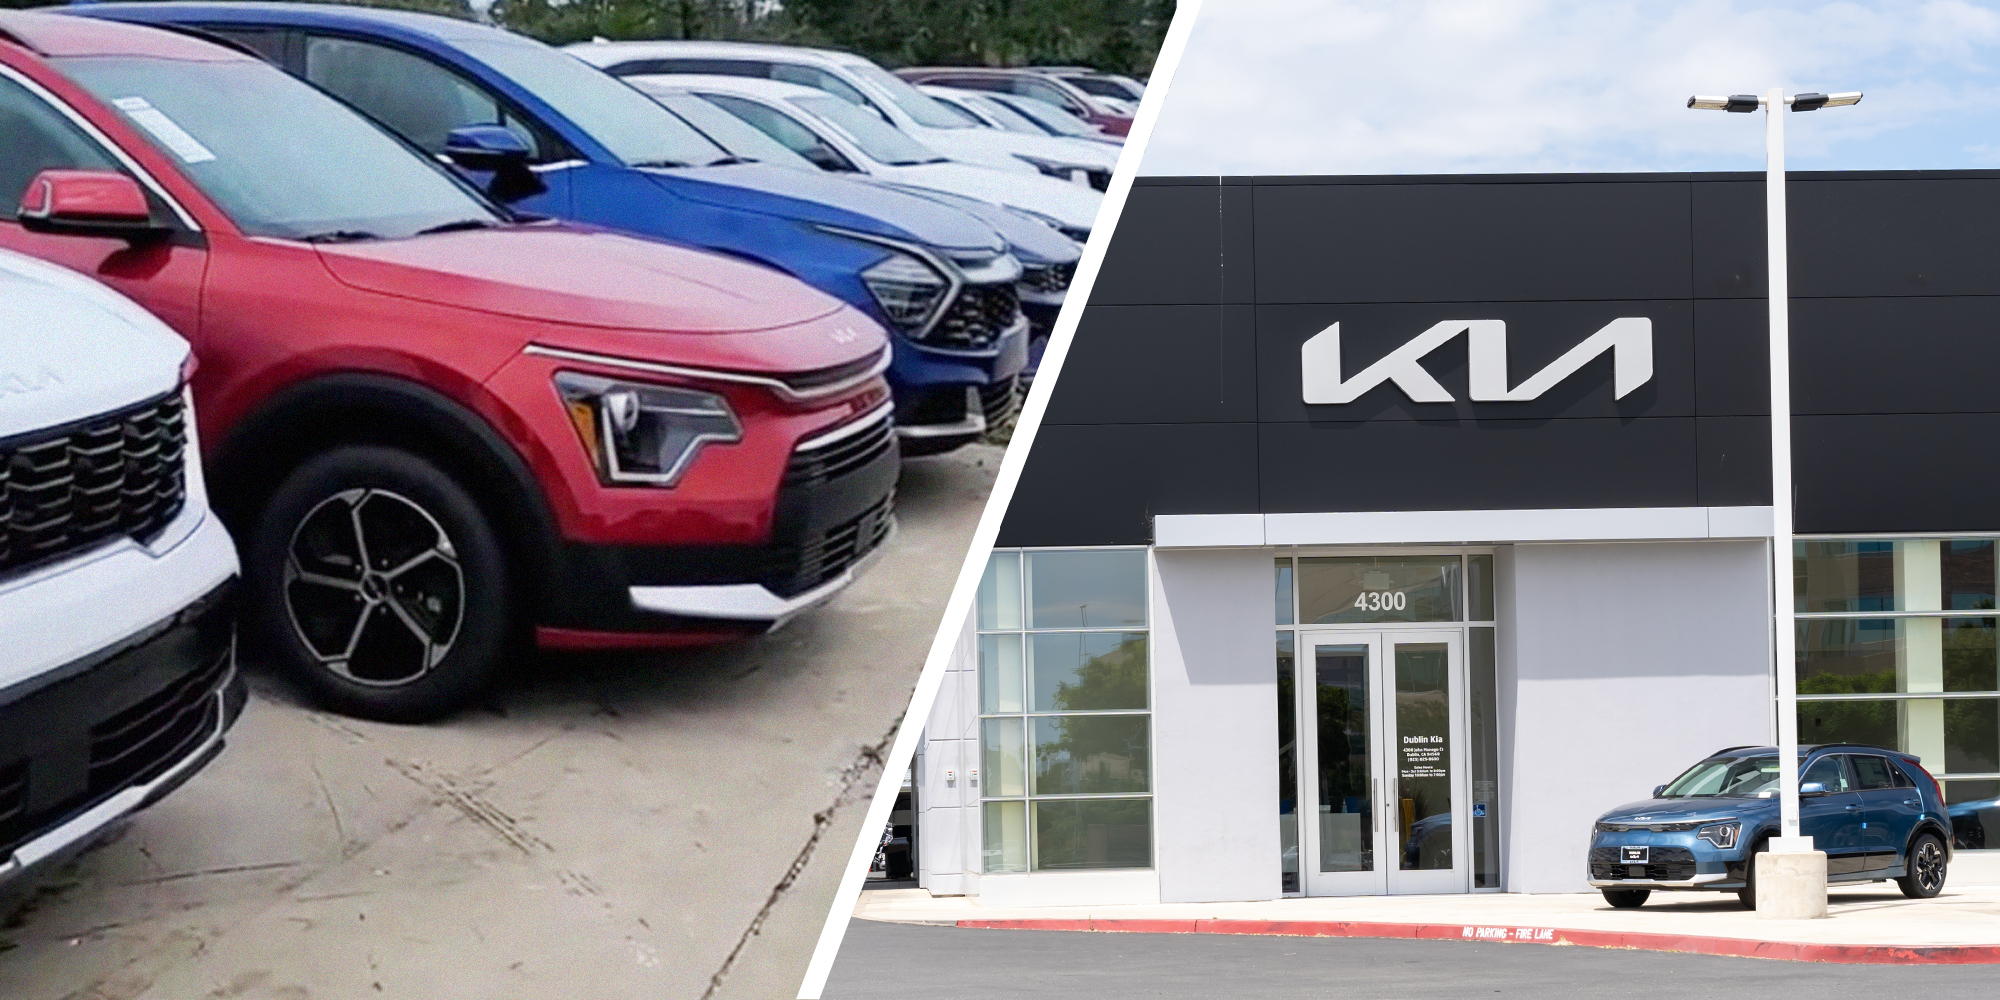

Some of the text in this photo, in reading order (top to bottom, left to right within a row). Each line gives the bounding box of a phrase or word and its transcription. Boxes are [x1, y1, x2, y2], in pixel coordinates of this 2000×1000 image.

[1302, 317, 1653, 404] KIA
[1354, 591, 1406, 612] 4300
[1403, 735, 1443, 744] Dublin Kia
[1462, 926, 1474, 938] NO
[1475, 927, 1508, 939] PARKING
[1515, 928, 1532, 939] FIRE
[1534, 928, 1554, 940] LANE
